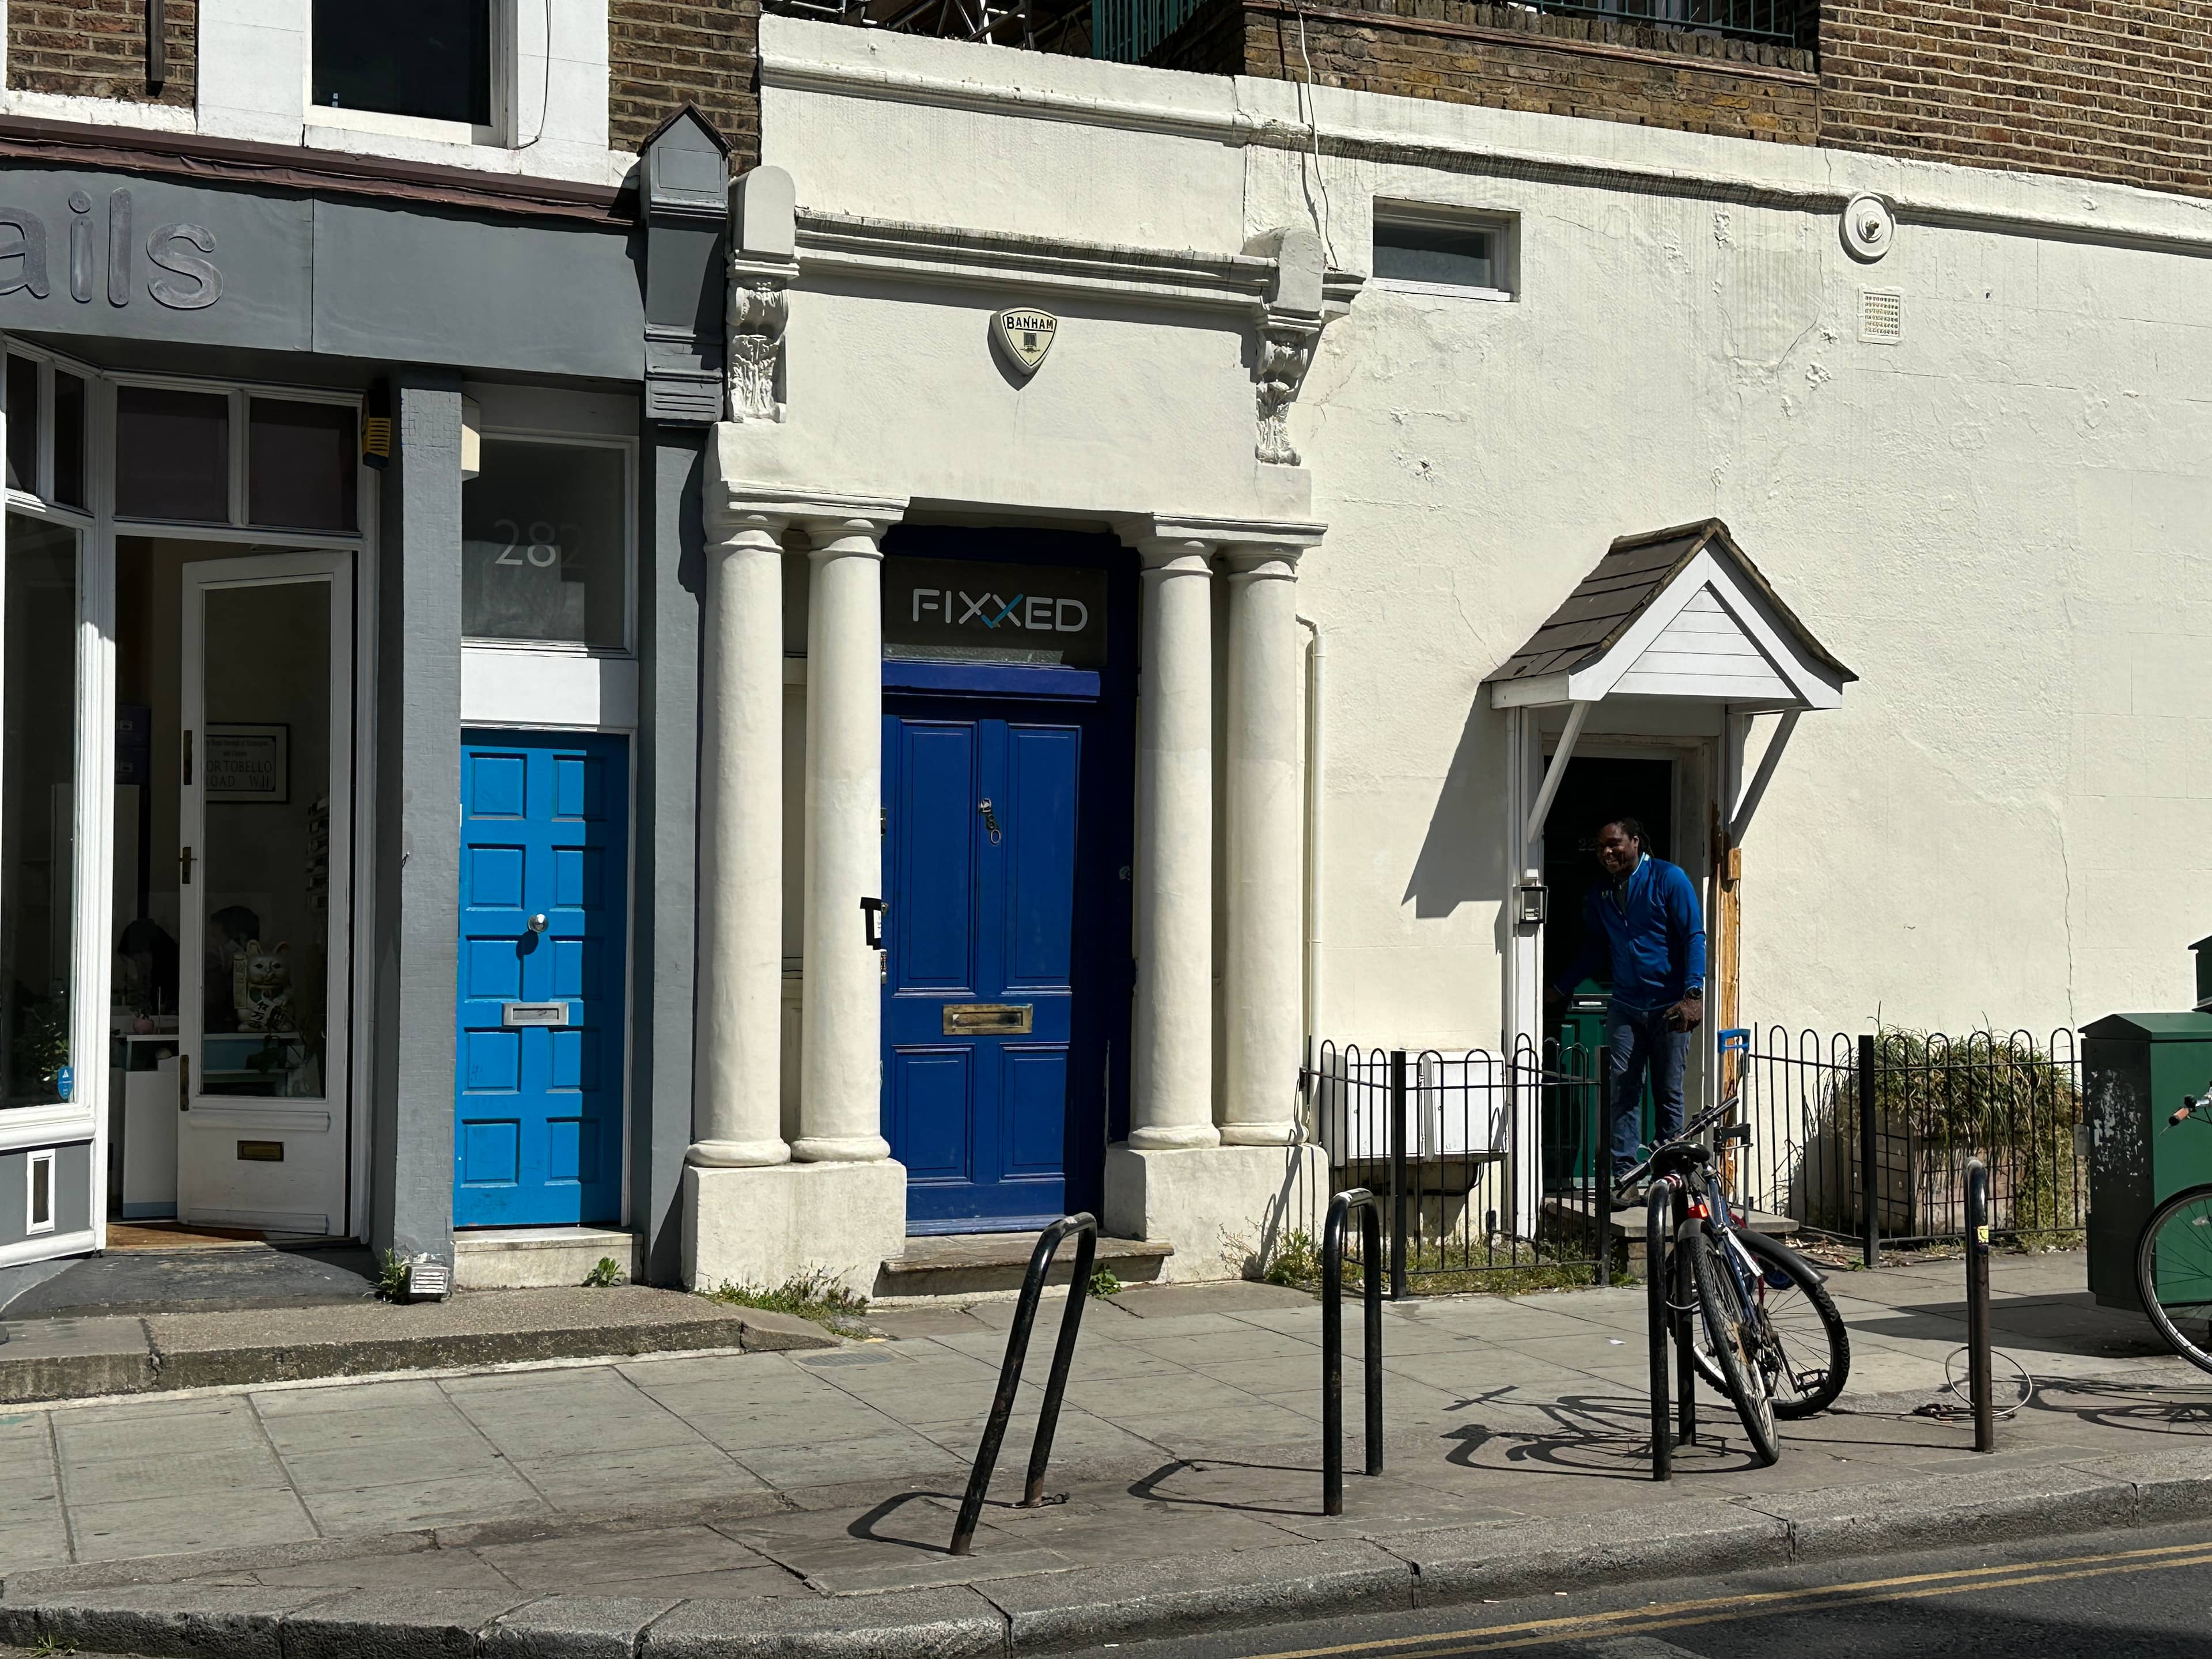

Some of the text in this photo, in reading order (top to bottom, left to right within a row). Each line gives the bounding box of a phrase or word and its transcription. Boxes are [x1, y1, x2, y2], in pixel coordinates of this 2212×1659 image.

[1006, 316, 1054, 330] BANHAM
[912, 588, 1088, 632] FIXXED
[206, 760, 272, 773] ORTOBELLO
